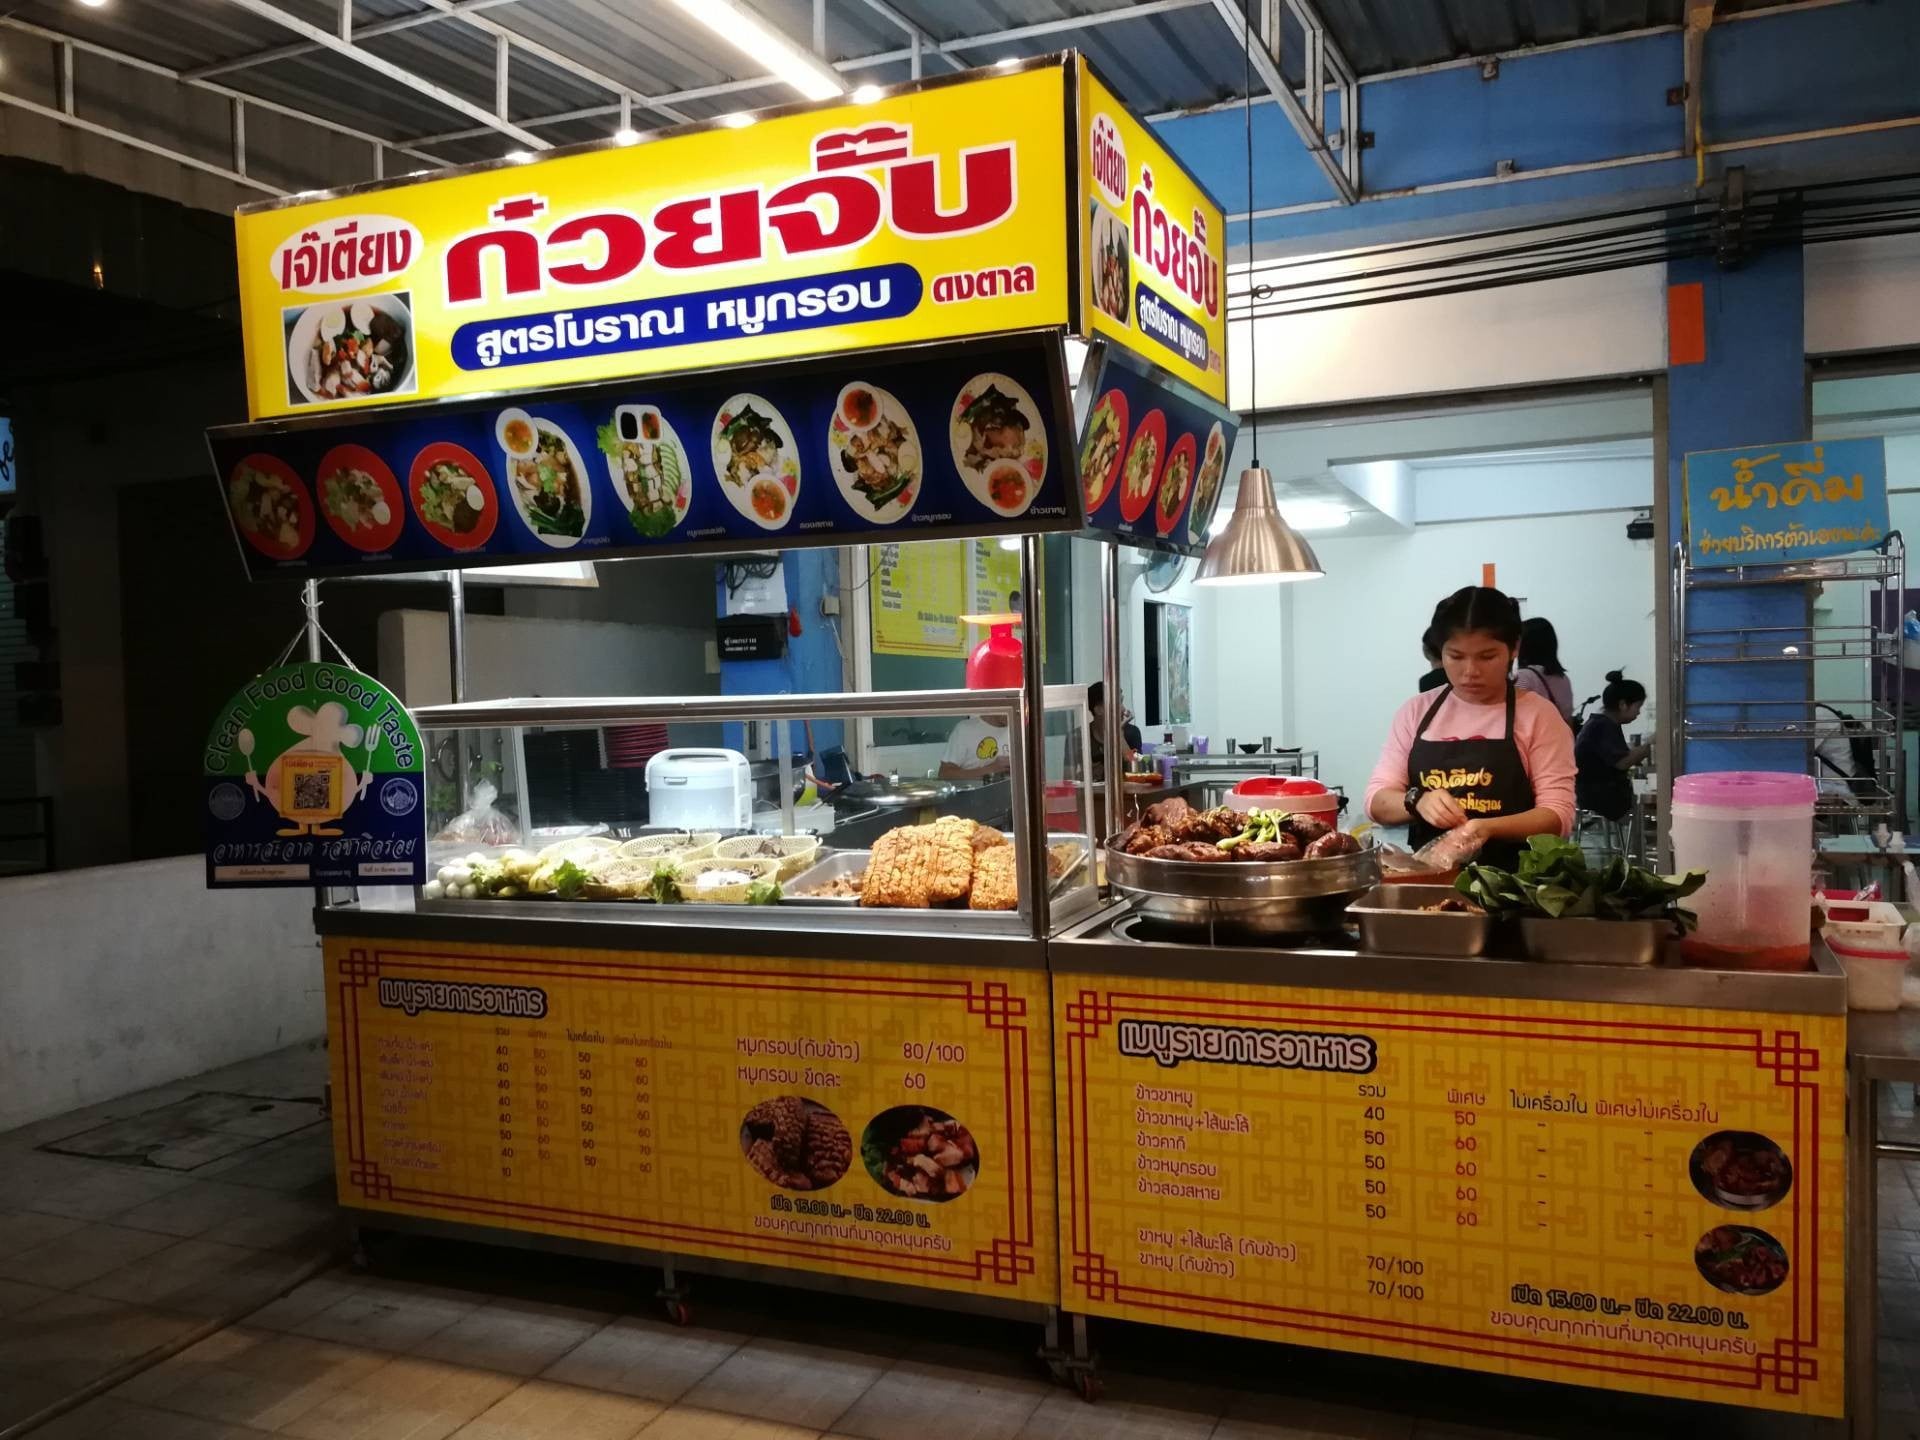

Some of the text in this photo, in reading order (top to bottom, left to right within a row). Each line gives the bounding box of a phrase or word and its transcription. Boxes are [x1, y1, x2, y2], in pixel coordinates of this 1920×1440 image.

[447, 127, 1012, 302] ก๋วยจั๊บ
[282, 221, 412, 289] เจ๊เตียง
[1133, 168, 1218, 317] ก๋วยจั๊บ
[933, 265, 1035, 302] ดงตาล
[476, 278, 891, 367] สูตรโบราณ หมูกรอบ
[204, 667, 415, 773] Clean Food Good Taste
[379, 979, 546, 1017] เมนูรายการอาหาร
[496, 1046, 508, 1056] 40
[578, 1052, 591, 1063] 50
[736, 1037, 965, 1064] หมูกรอบ(กับข้าว) 80/100
[1121, 1021, 1375, 1073] เมนูรายการอาหาร
[497, 1063, 509, 1073] 40
[579, 1069, 591, 1080] 50
[497, 1080, 510, 1090] 40
[580, 1086, 592, 1097] 50
[737, 1066, 926, 1089] หมูกรอบ ขีดละ 60
[499, 1097, 511, 1107] 40
[580, 1104, 593, 1115] 50
[1136, 1083, 1476, 1126] ข้าวขาหมู 40 50
[1358, 1084, 1387, 1099] รวม
[1447, 1088, 1486, 1106] พิเศษ
[1509, 1089, 1588, 1114] ไม่เครื่องใน
[500, 1113, 512, 1124] 40
[581, 1121, 594, 1132] 50
[500, 1130, 512, 1140] 50
[1364, 1131, 1385, 1146] 50
[1455, 1137, 1477, 1151] 60
[501, 1148, 514, 1158] 40
[584, 1156, 597, 1167] 50
[1365, 1155, 1386, 1170] 50
[1455, 1162, 1477, 1176] 60
[1137, 1153, 1477, 1201] ข้าวหมูกรอบ 50 60
[795, 1199, 829, 1216] 15.00
[876, 1208, 914, 1226] 22.00
[1138, 1176, 1478, 1226] ข้าวสองสหาย 50 60
[1139, 1229, 1173, 1248] ขาหมู
[1239, 1237, 1296, 1262] (กับข้าว)
[1367, 1255, 1424, 1275] 70/100
[1140, 1252, 1424, 1300] ขาหมู (กับข้าว) 70/100
[1511, 1284, 1542, 1305] เปิด
[1547, 1290, 1596, 1312] 15.00
[1635, 1298, 1663, 1320] ปิด
[1668, 1303, 1723, 1326] 22.00
[1727, 1311, 1749, 1330] น.
[1490, 1309, 1757, 1356] ขอบคุณทุกท่านที่มาอุดหนุนครับ
